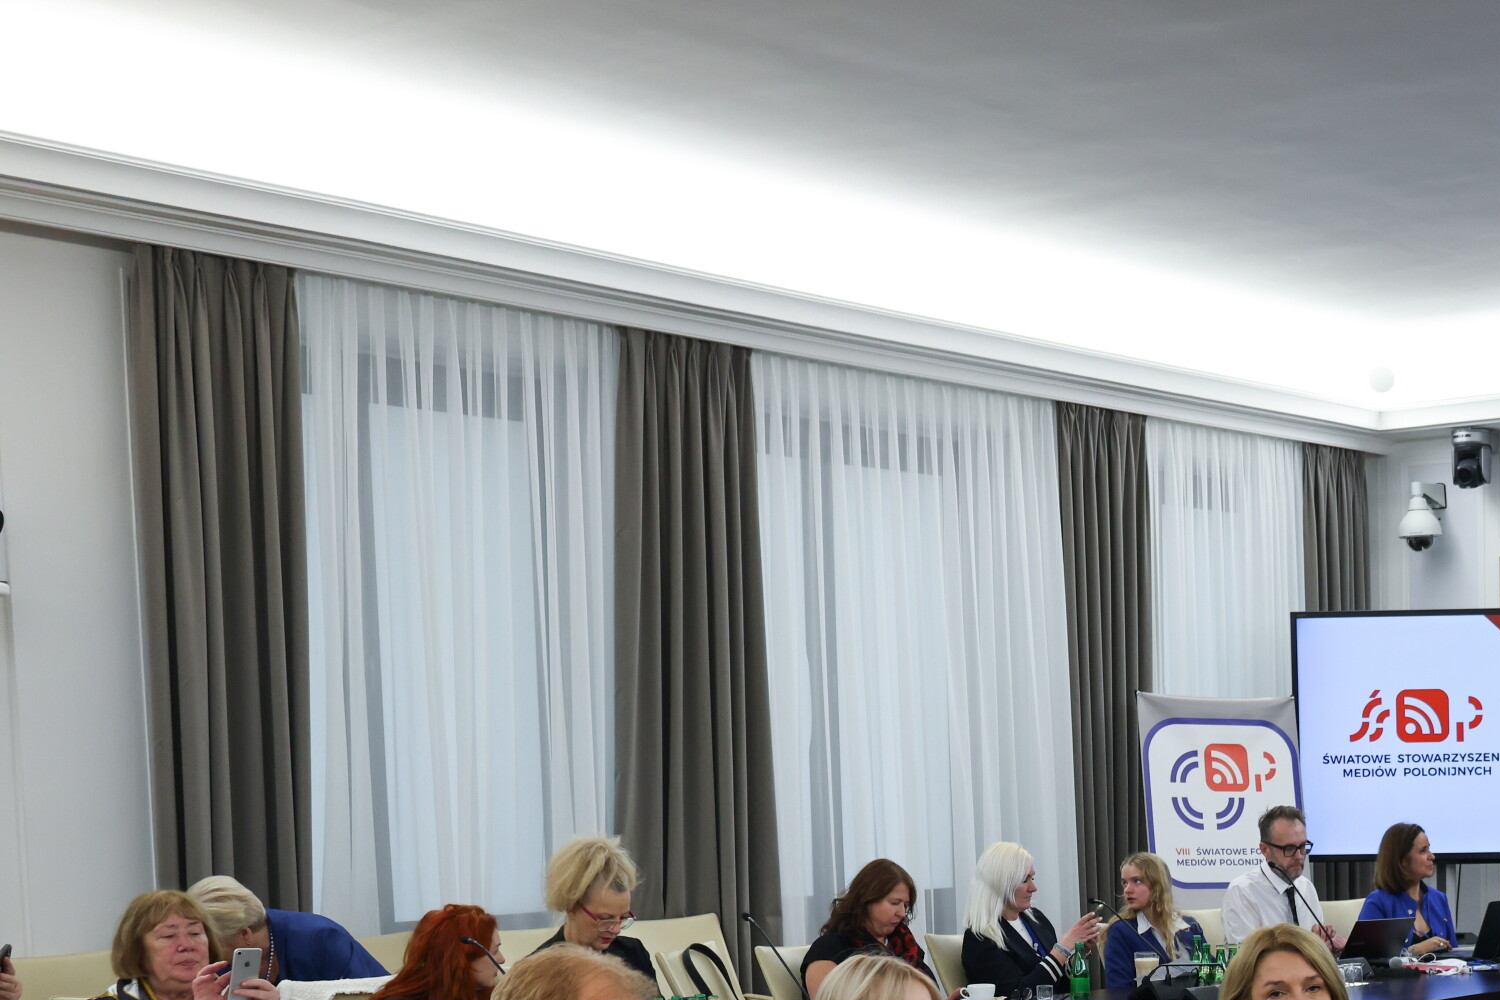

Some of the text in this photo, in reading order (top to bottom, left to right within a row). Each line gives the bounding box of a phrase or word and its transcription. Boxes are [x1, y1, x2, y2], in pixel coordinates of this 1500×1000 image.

[1322, 752, 1391, 765] ŚWIATOWE
[1343, 766, 1492, 778] MEDIÓW POLONIJNYCH
[1175, 847, 1190, 856] VIII
[1196, 846, 1248, 856] ŚWIATOWE
[1176, 858, 1264, 867] MEDIÓW POLONIJN
